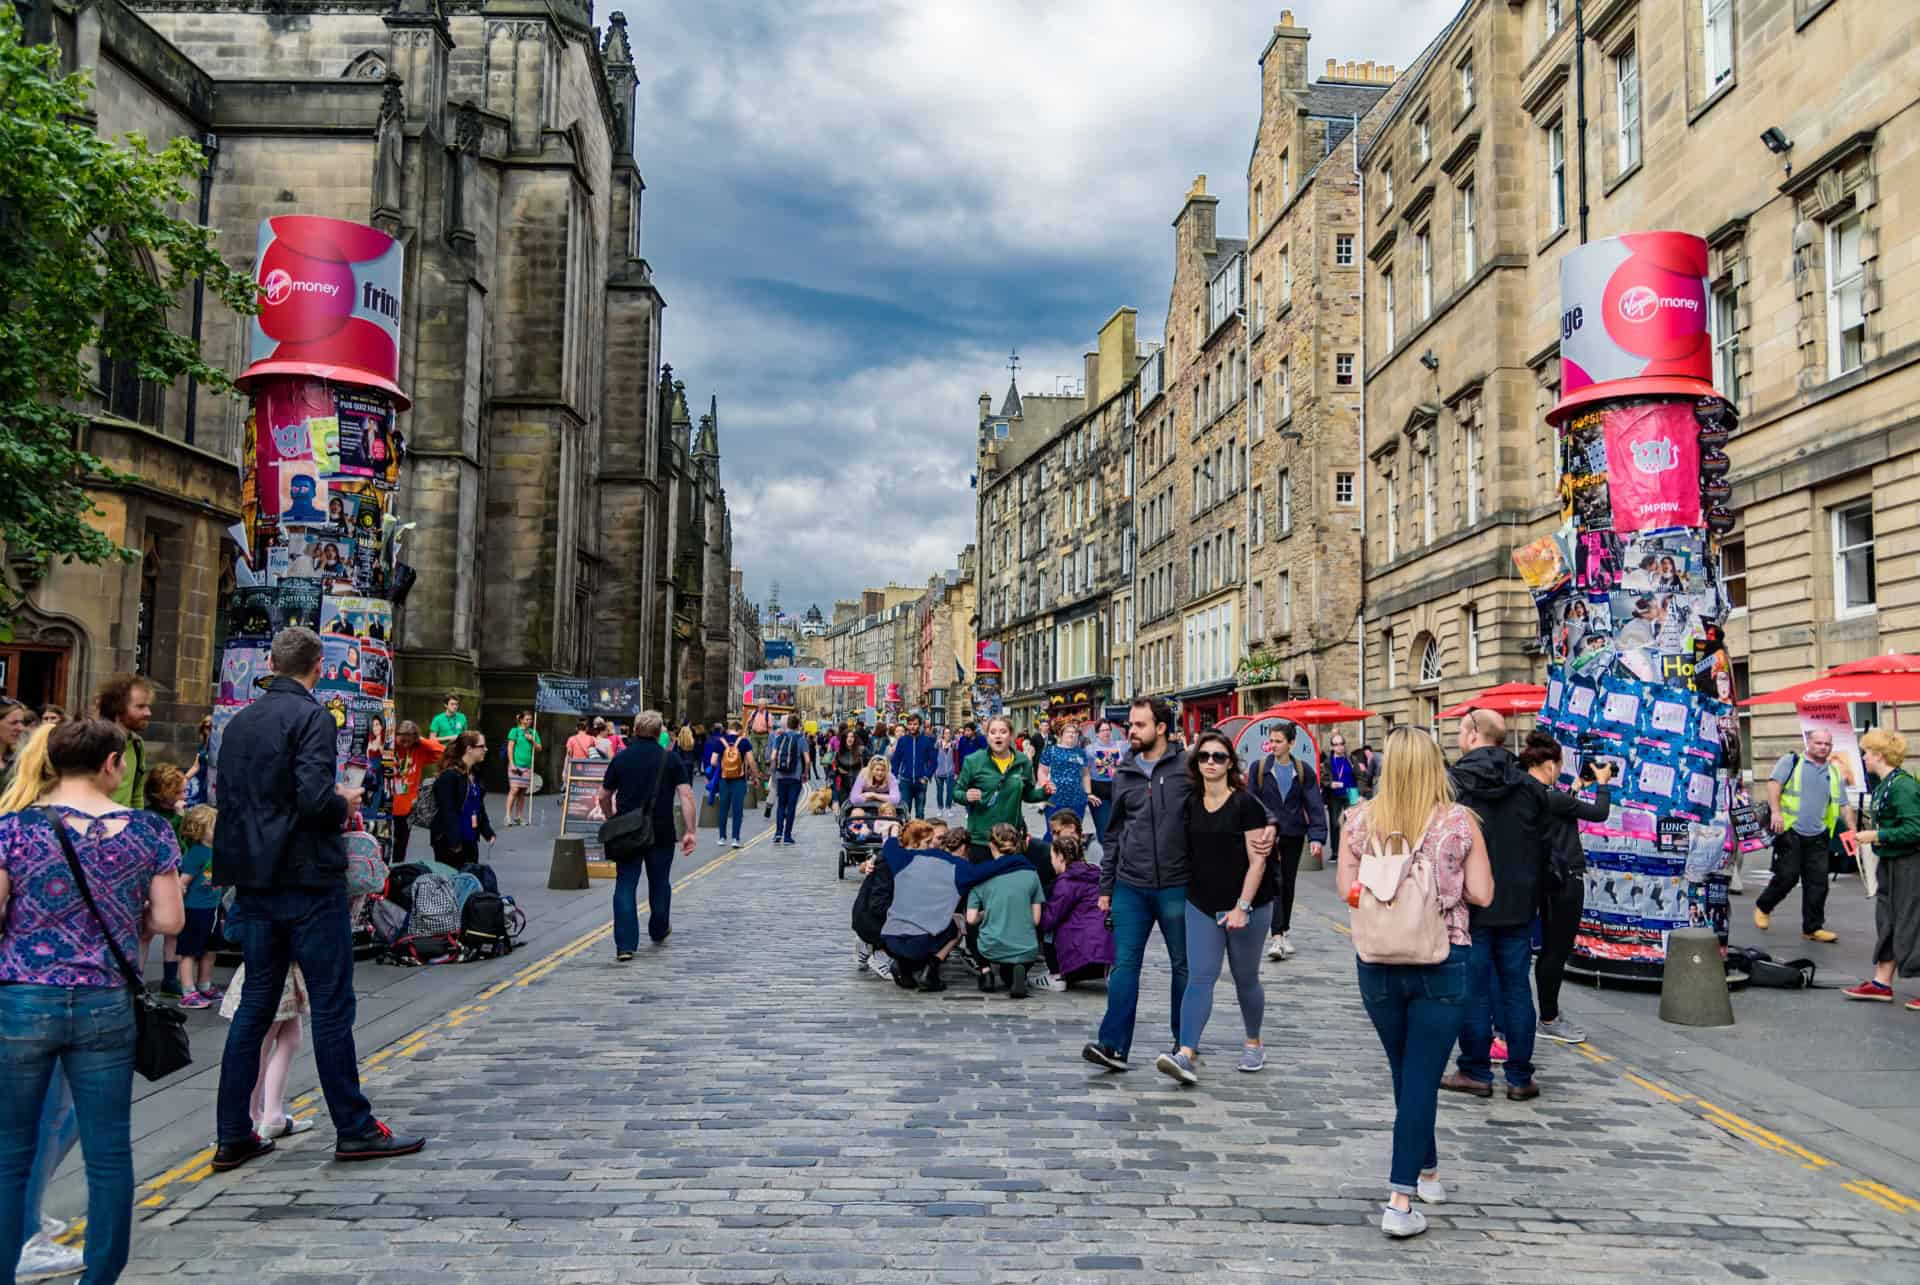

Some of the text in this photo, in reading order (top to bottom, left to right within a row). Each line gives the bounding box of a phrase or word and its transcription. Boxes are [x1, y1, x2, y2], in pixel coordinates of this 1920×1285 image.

[292, 279, 340, 297] money
[1659, 296, 1699, 312] money
[1802, 704, 1840, 712] SCOTTISH
